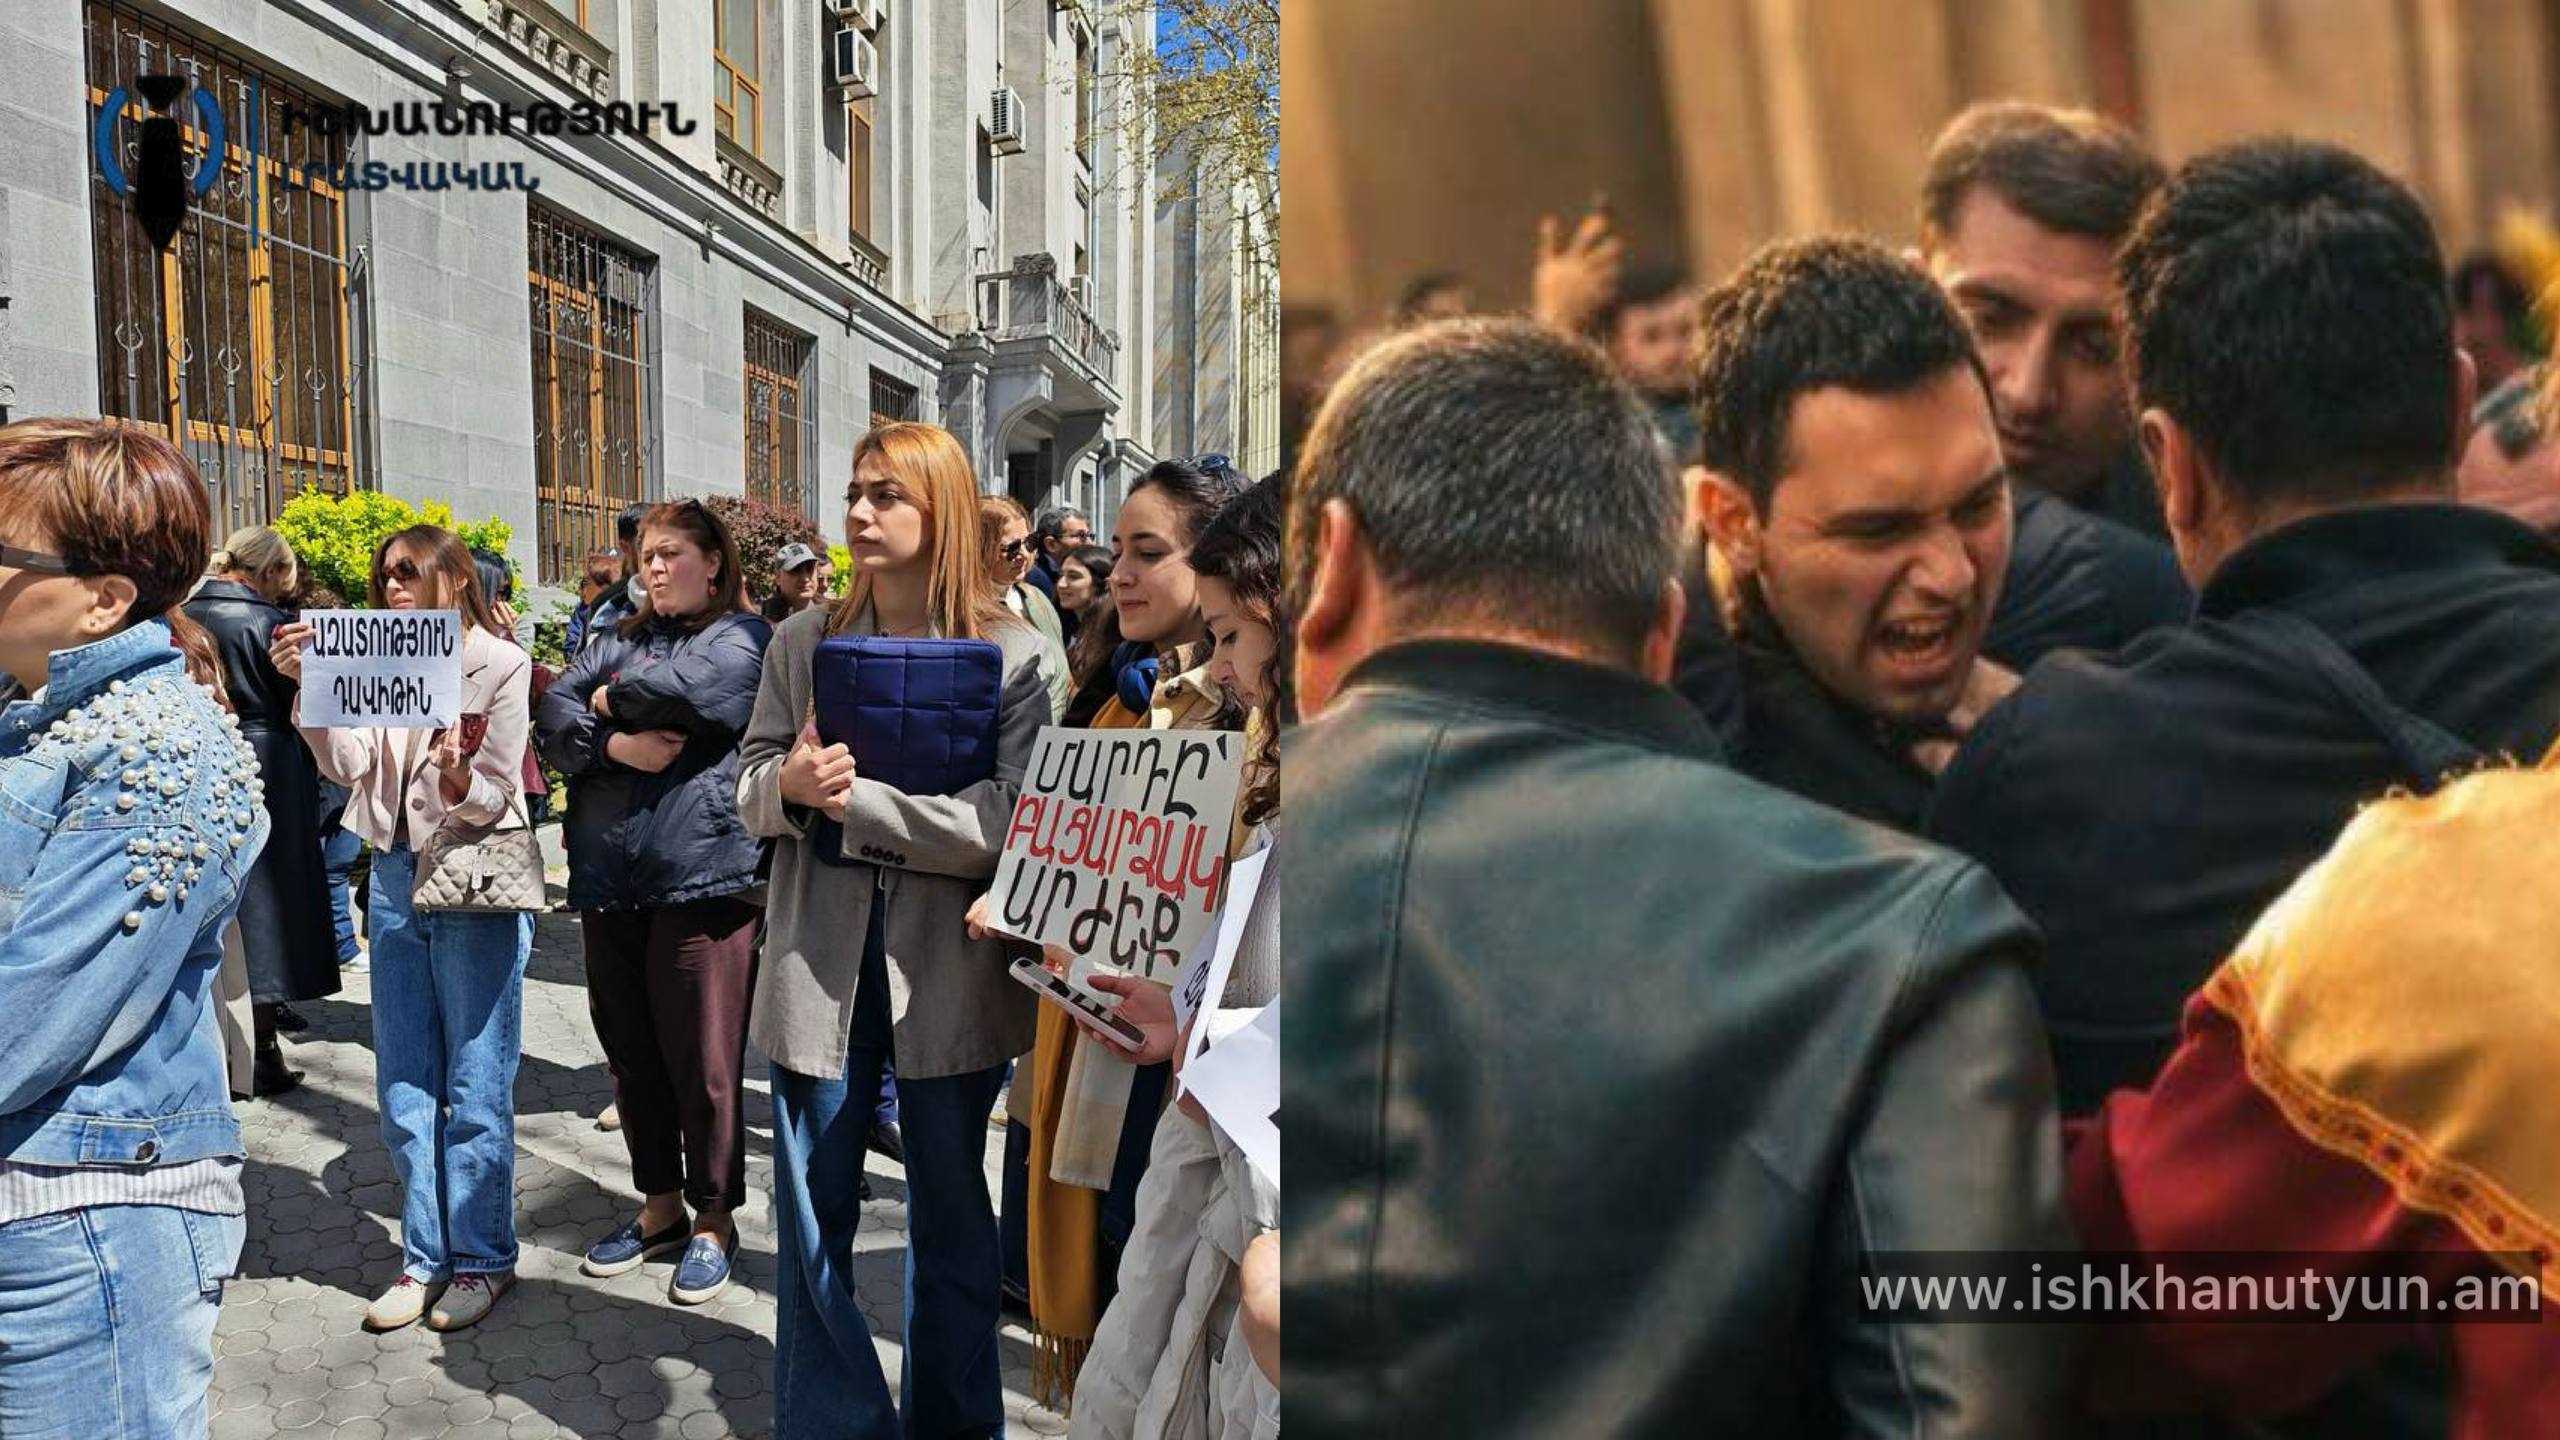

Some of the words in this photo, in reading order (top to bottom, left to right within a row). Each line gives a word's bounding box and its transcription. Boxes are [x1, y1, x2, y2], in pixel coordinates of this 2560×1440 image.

[312, 616, 453, 657] ԱԶԱՏՈՒԹՅՈՒՆ
[333, 675, 432, 717] ԴԱՎԻԹԻՆ
[1006, 793, 1223, 913] ԲԱՑԱՐՁԱԿ
[1003, 857, 1181, 977] ԱՐԺԵՔ
